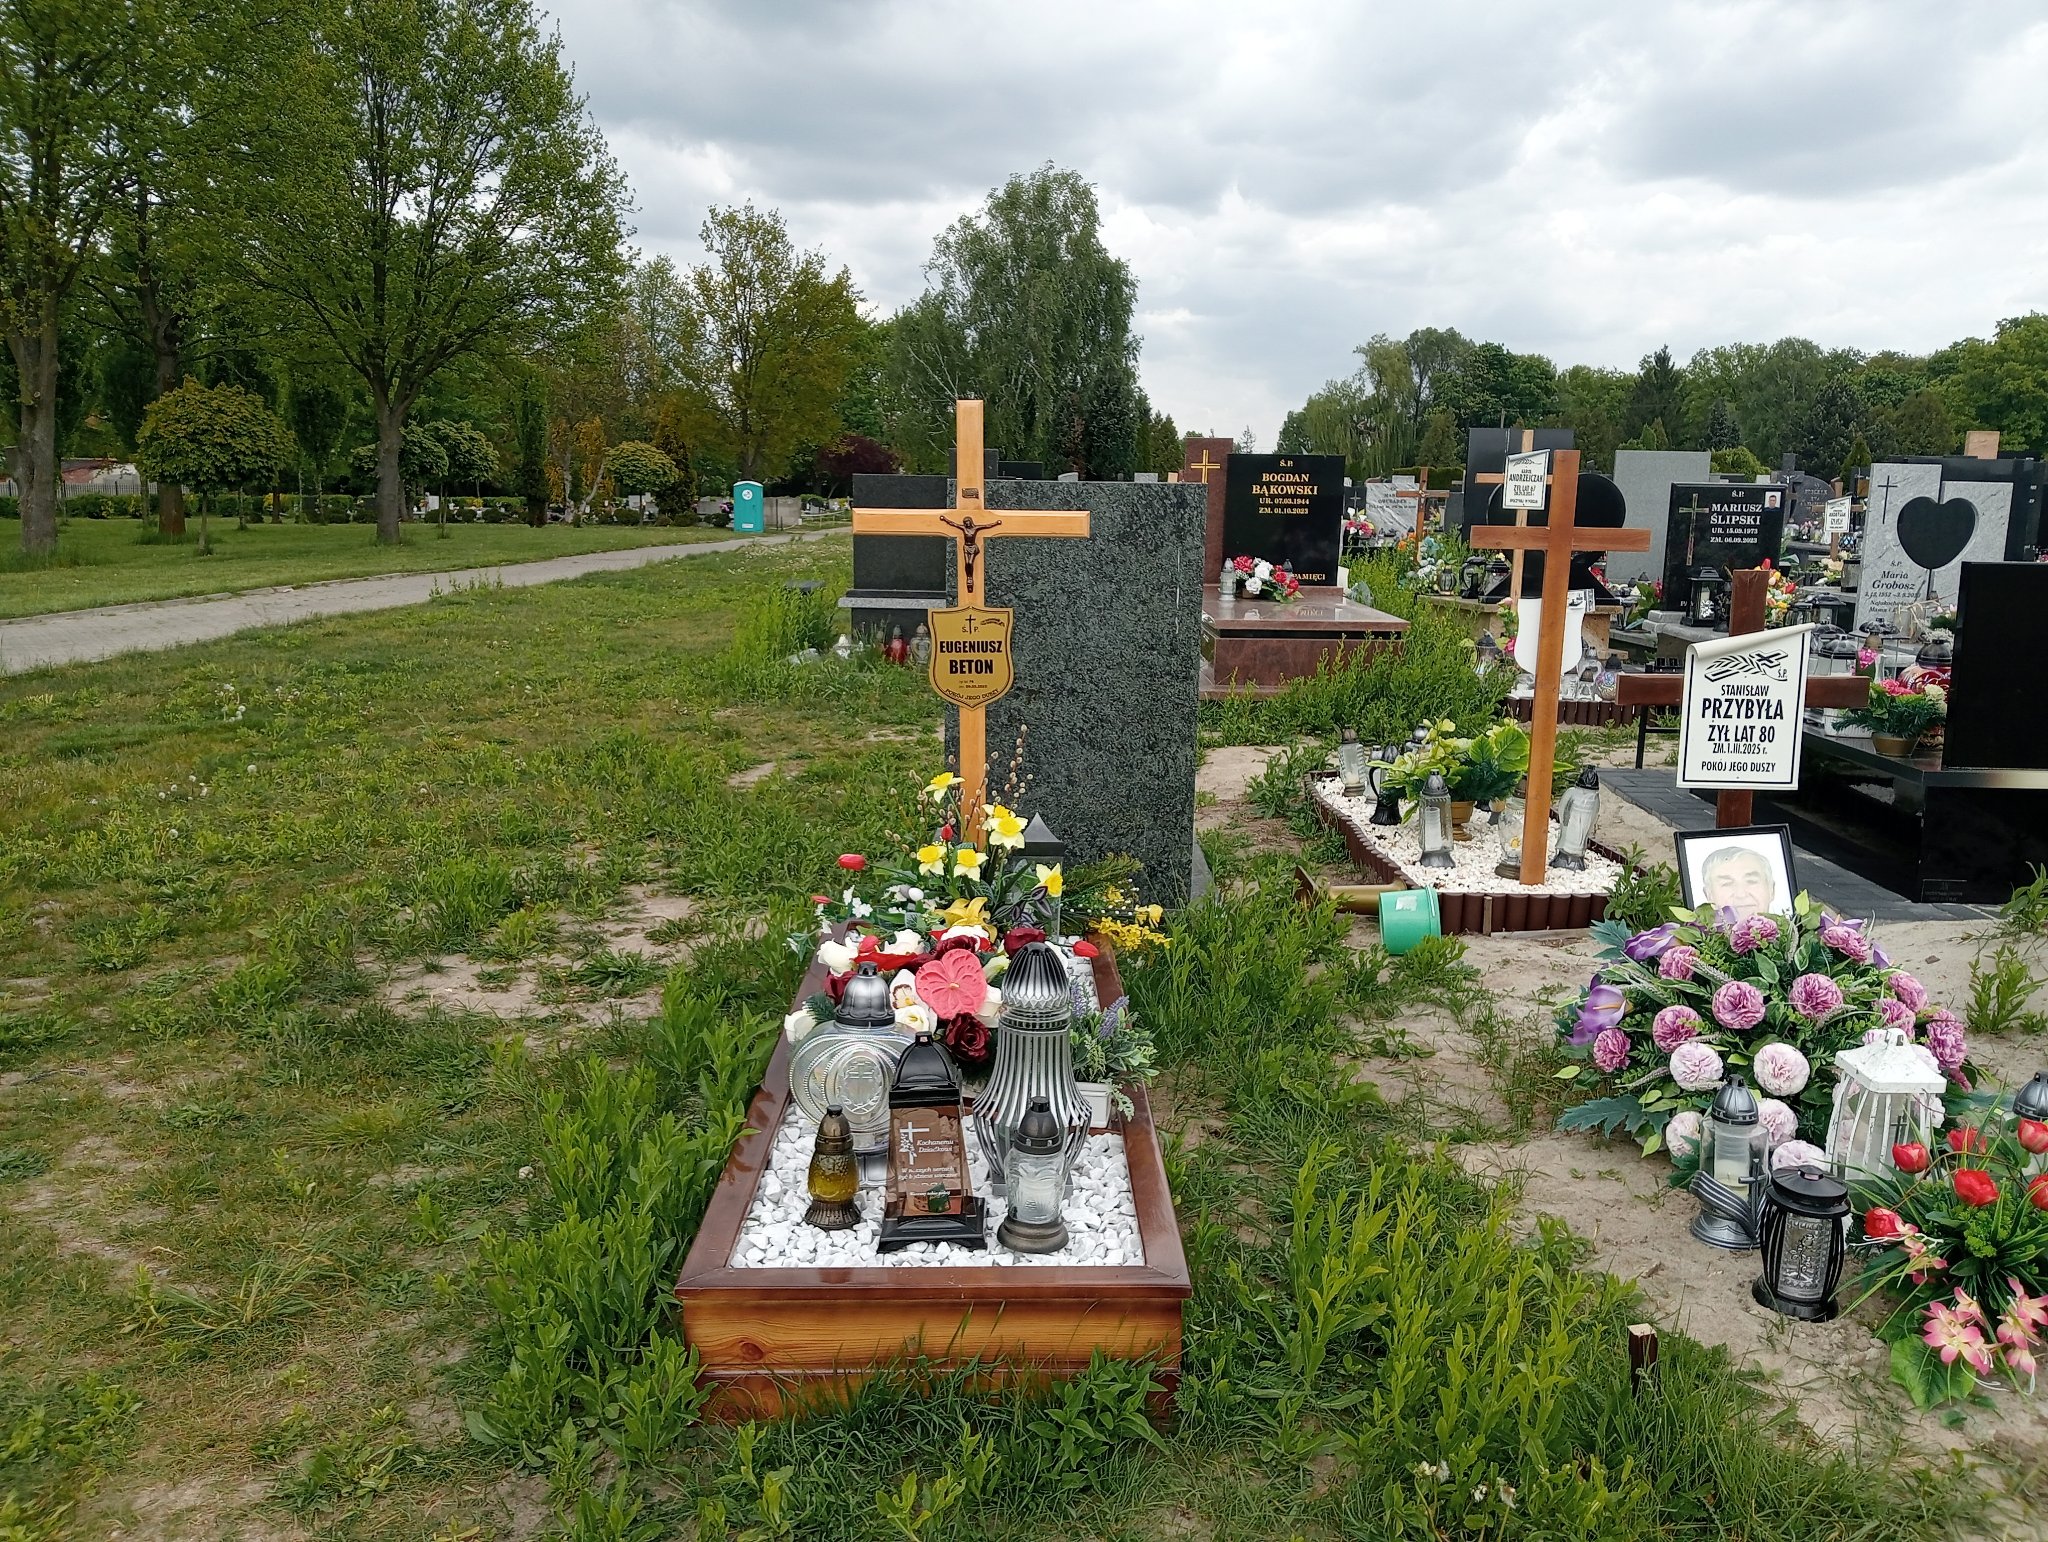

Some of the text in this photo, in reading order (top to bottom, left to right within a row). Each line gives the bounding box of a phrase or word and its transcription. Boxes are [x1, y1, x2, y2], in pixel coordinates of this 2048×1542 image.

[1261, 473, 1310, 482] BOGDAN
[1251, 485, 1319, 496] BĄKOWSKI
[1711, 503, 1763, 513] MARIUSZ
[1710, 513, 1761, 525] ŚLIPSKI
[1881, 570, 1909, 579] Maria
[1872, 579, 1916, 590] Grobosz
[939, 640, 1003, 654] EUGENIUSZ
[949, 659, 994, 675] BETON
[1721, 684, 1770, 697] STANISŁAW
[1701, 698, 1784, 720] PRZYBYŁA
[1707, 720, 1775, 743] ŻYŁ LAT 80
[1701, 759, 1776, 772] POKÓJ JEGO DUSZY
